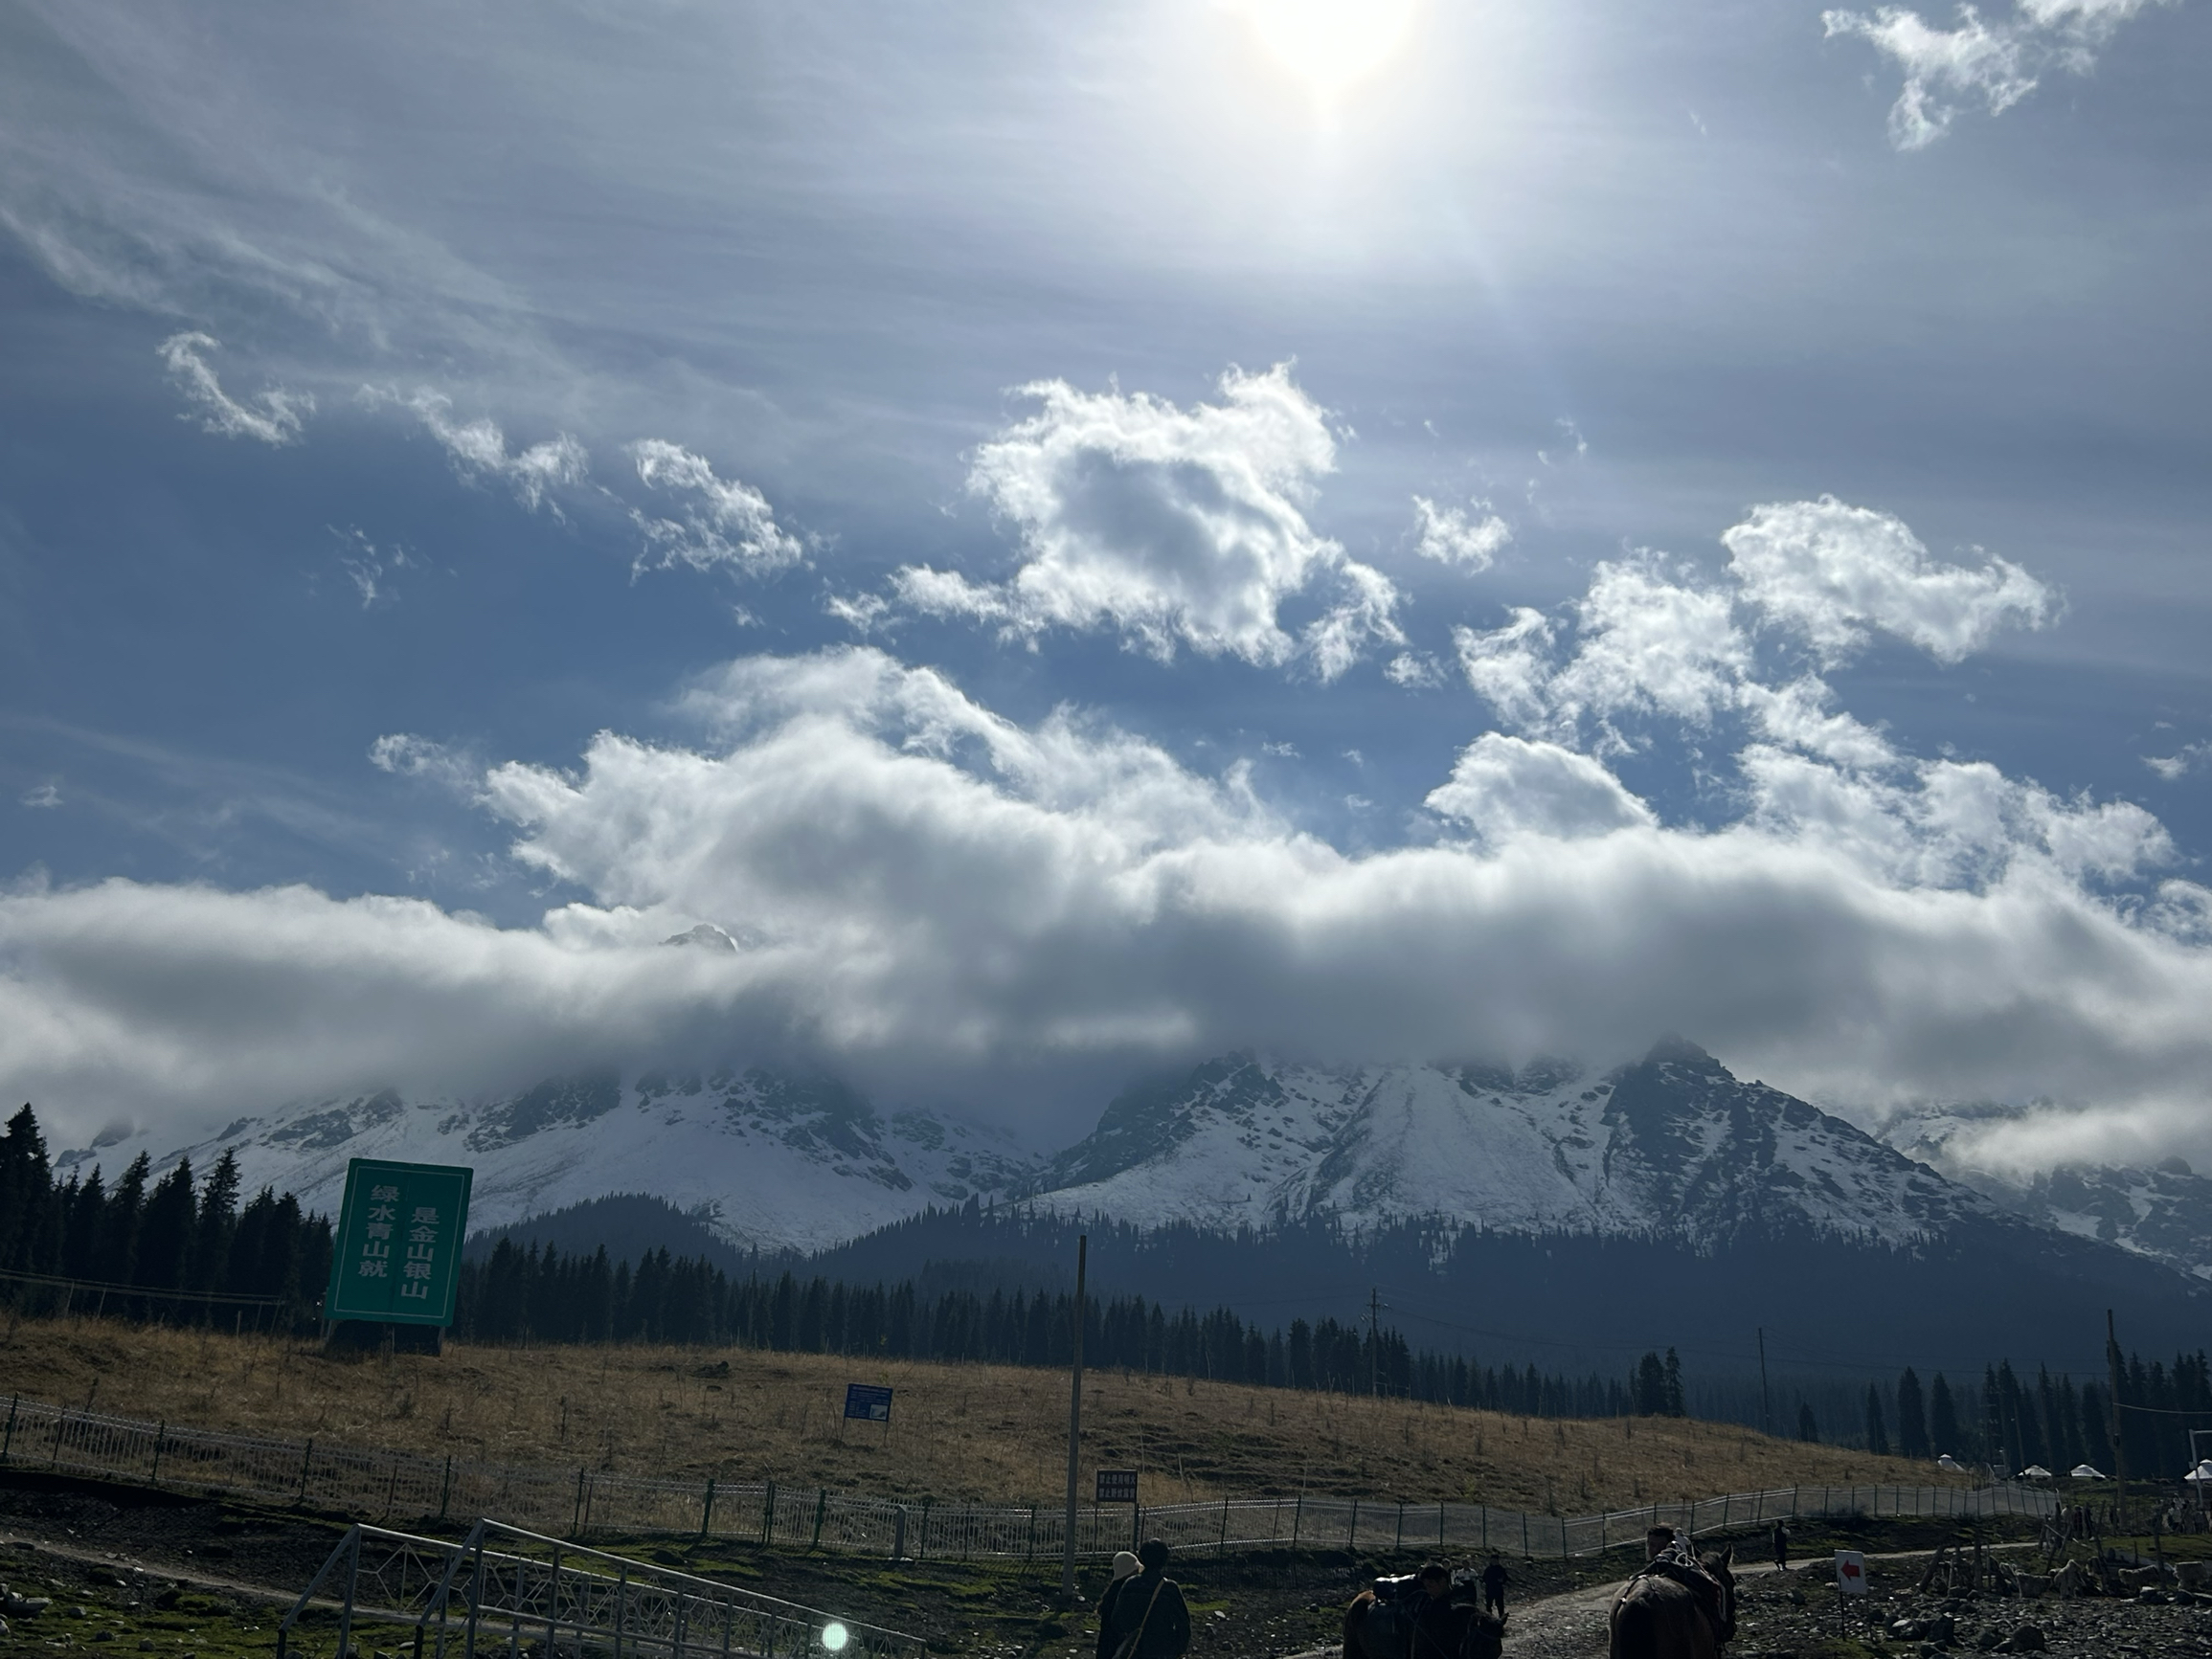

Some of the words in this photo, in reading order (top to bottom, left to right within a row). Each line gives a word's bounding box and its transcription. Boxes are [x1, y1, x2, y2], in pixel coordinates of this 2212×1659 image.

[358, 1184, 400, 1278] 绿水青山就
[400, 1207, 440, 1300] 是金山银山
[1099, 1474, 1136, 1485] 禁止使用明火
